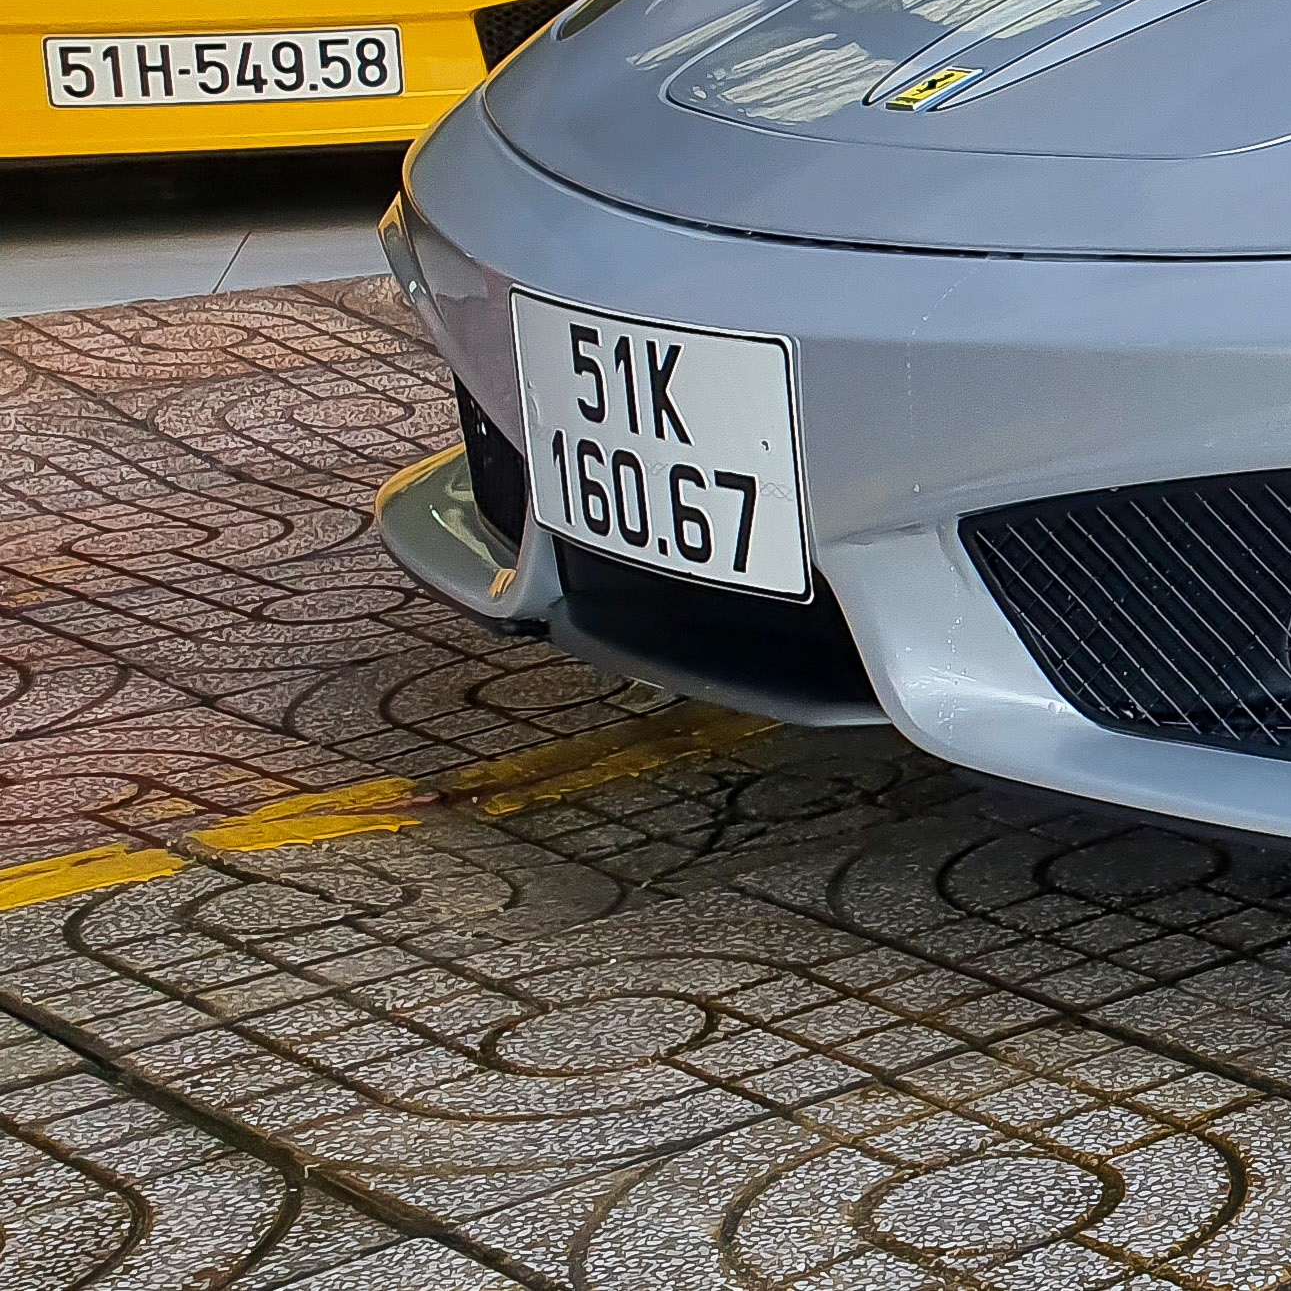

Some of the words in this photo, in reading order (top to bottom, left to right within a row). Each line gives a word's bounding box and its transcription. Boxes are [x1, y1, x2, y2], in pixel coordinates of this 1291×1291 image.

[58, 37, 390, 100] 51H-549.58
[569, 322, 695, 446] 51K
[552, 428, 758, 575] 160.67
